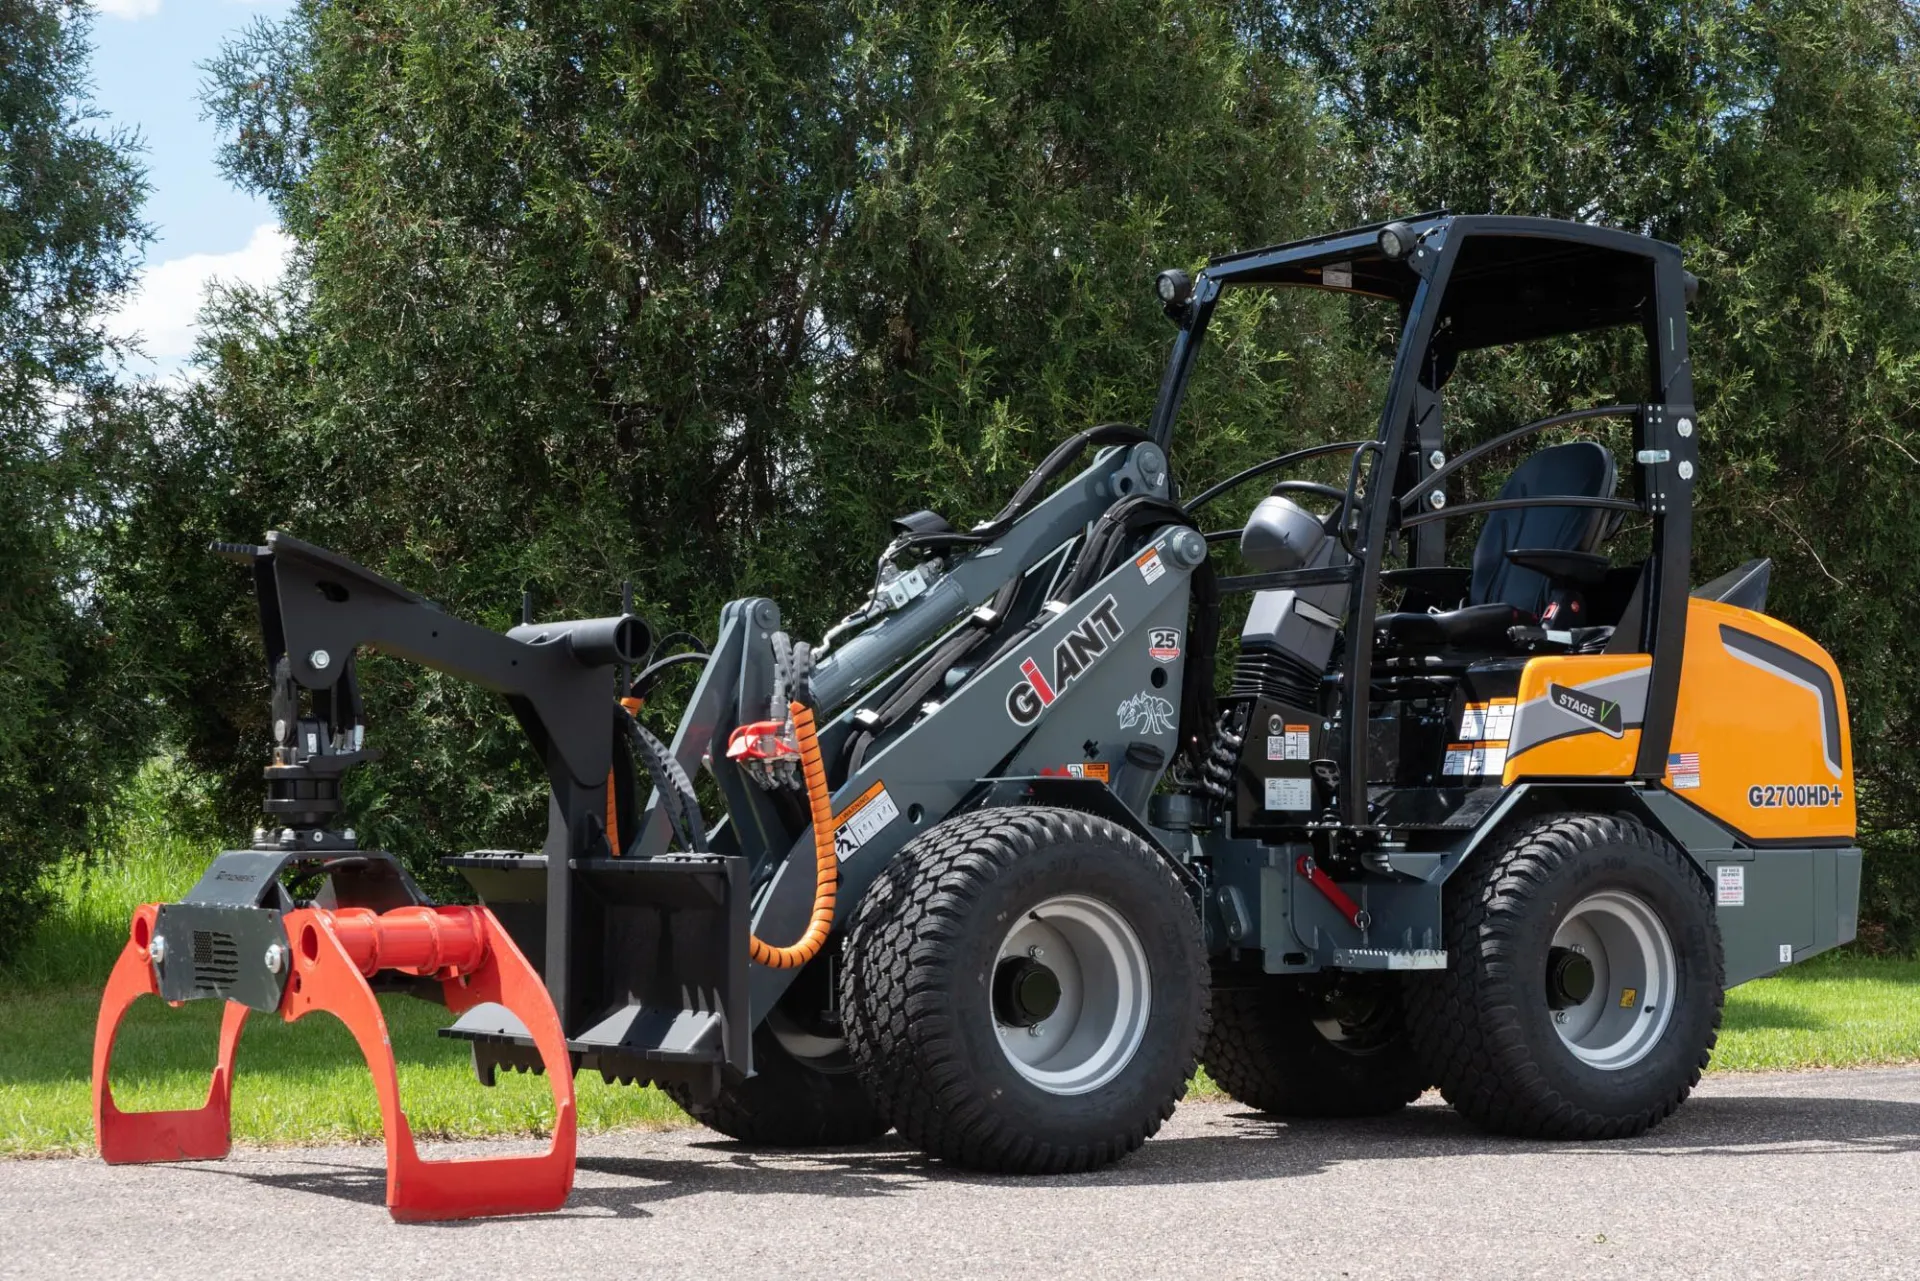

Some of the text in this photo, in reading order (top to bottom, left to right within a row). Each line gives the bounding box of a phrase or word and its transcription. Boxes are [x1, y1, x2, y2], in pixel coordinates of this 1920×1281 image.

[1154, 632, 1176, 648] 25
[1559, 693, 1618, 722] STAGE V
[1747, 784, 1843, 807] G2700HD+
